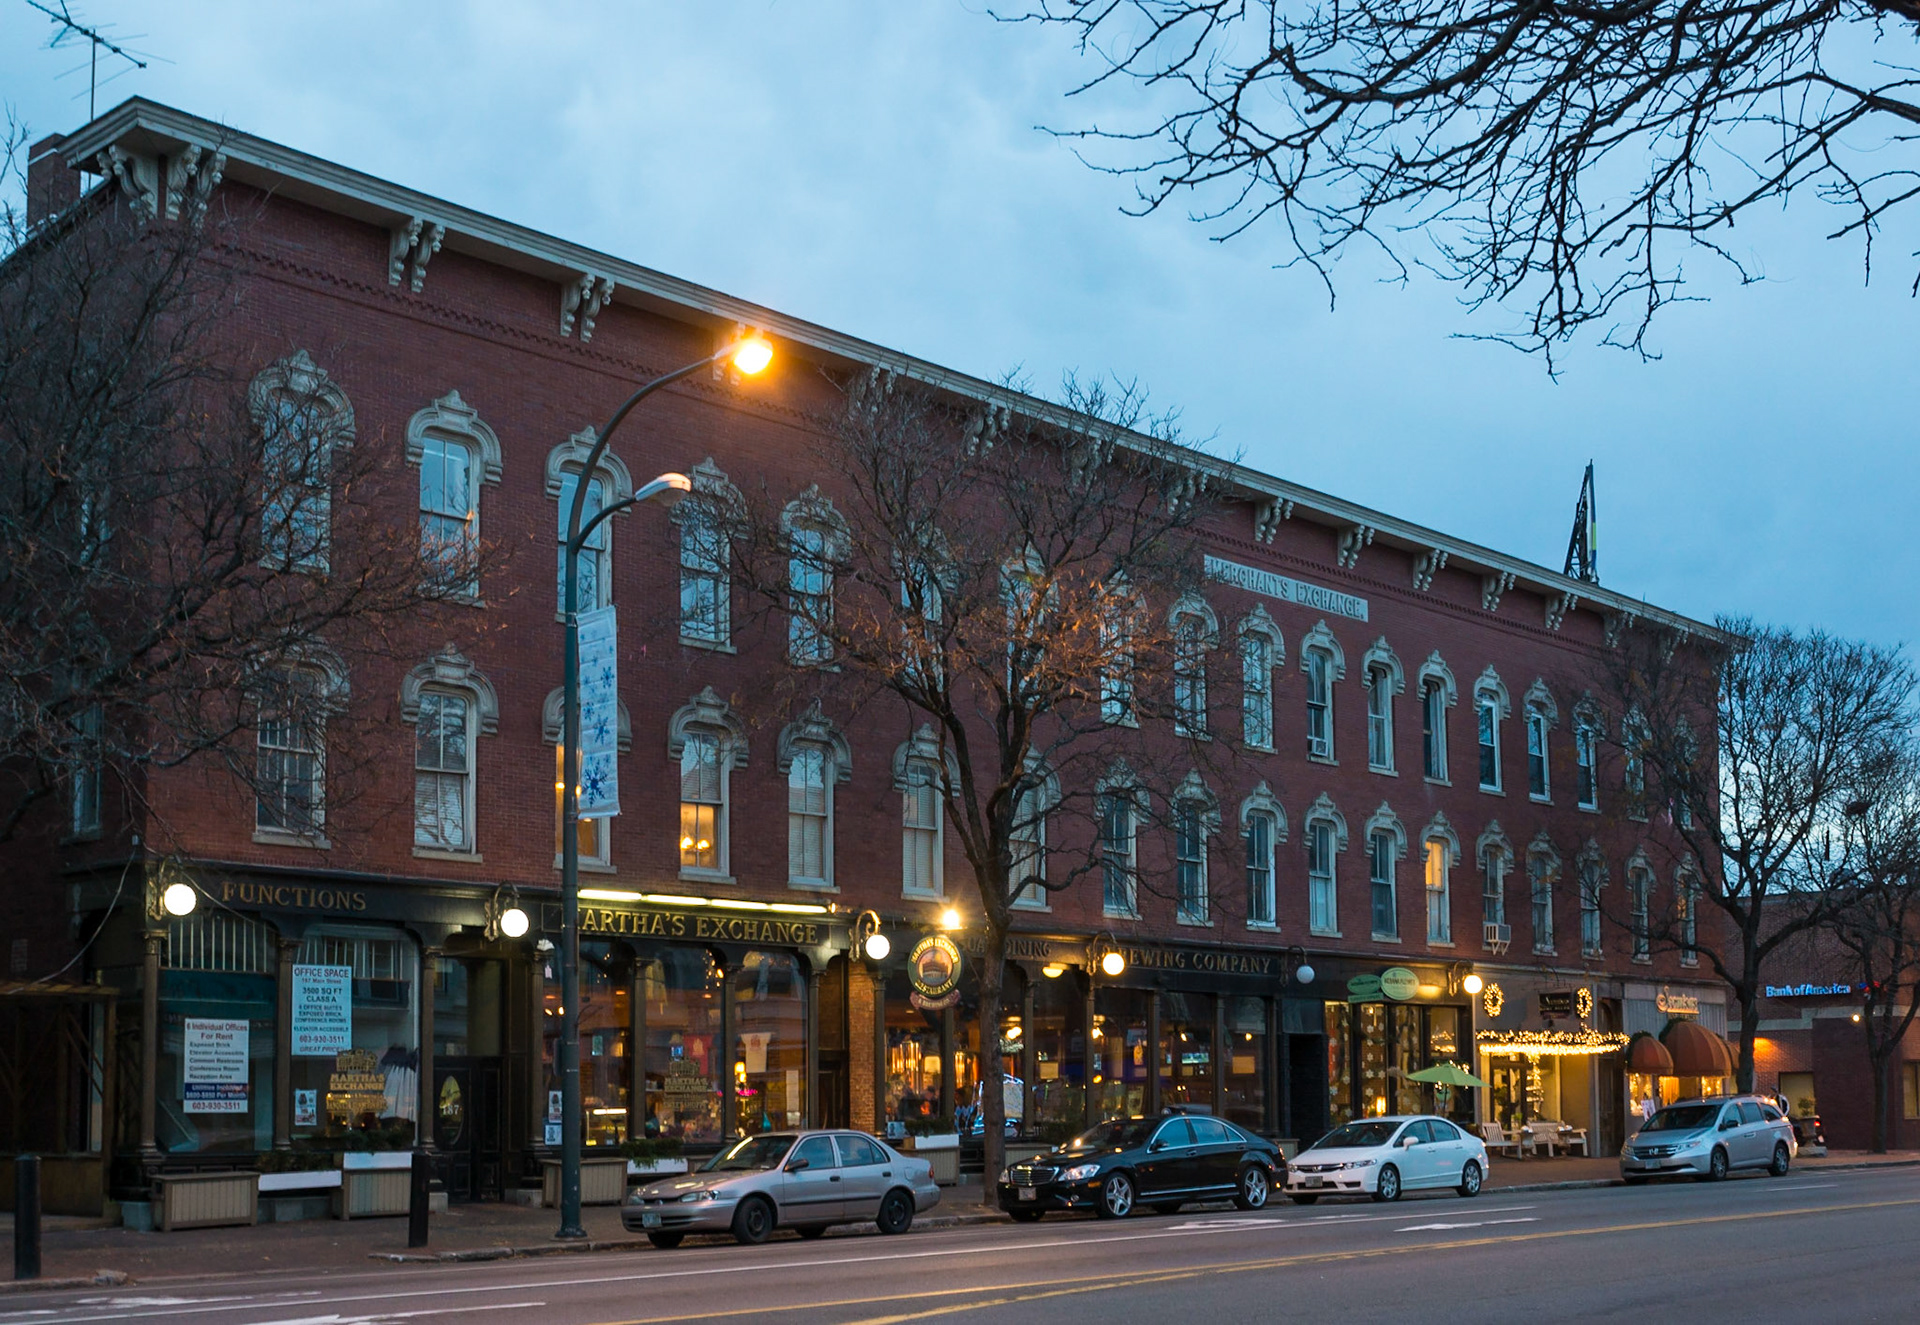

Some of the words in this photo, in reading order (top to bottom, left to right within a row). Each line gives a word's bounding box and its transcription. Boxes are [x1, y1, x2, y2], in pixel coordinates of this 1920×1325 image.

[221, 880, 367, 911] FUNCTIONS
[578, 908, 686, 936] ARTHA'S
[696, 916, 819, 944] EXCHANGE
[1193, 952, 1272, 974] COMPANY
[294, 967, 322, 977] OFFICE
[324, 968, 349, 978] SPACE
[321, 987, 332, 995] SQ
[1765, 985, 1793, 997] Bank
[1794, 984, 1805, 996] of
[1805, 983, 1851, 995] America
[306, 995, 330, 1003] CLASS
[192, 1022, 224, 1031] Individual
[225, 1023, 247, 1032] Offices
[330, 1073, 385, 1082] MARTHA'S
[329, 1082, 385, 1090] EXCHANGE
